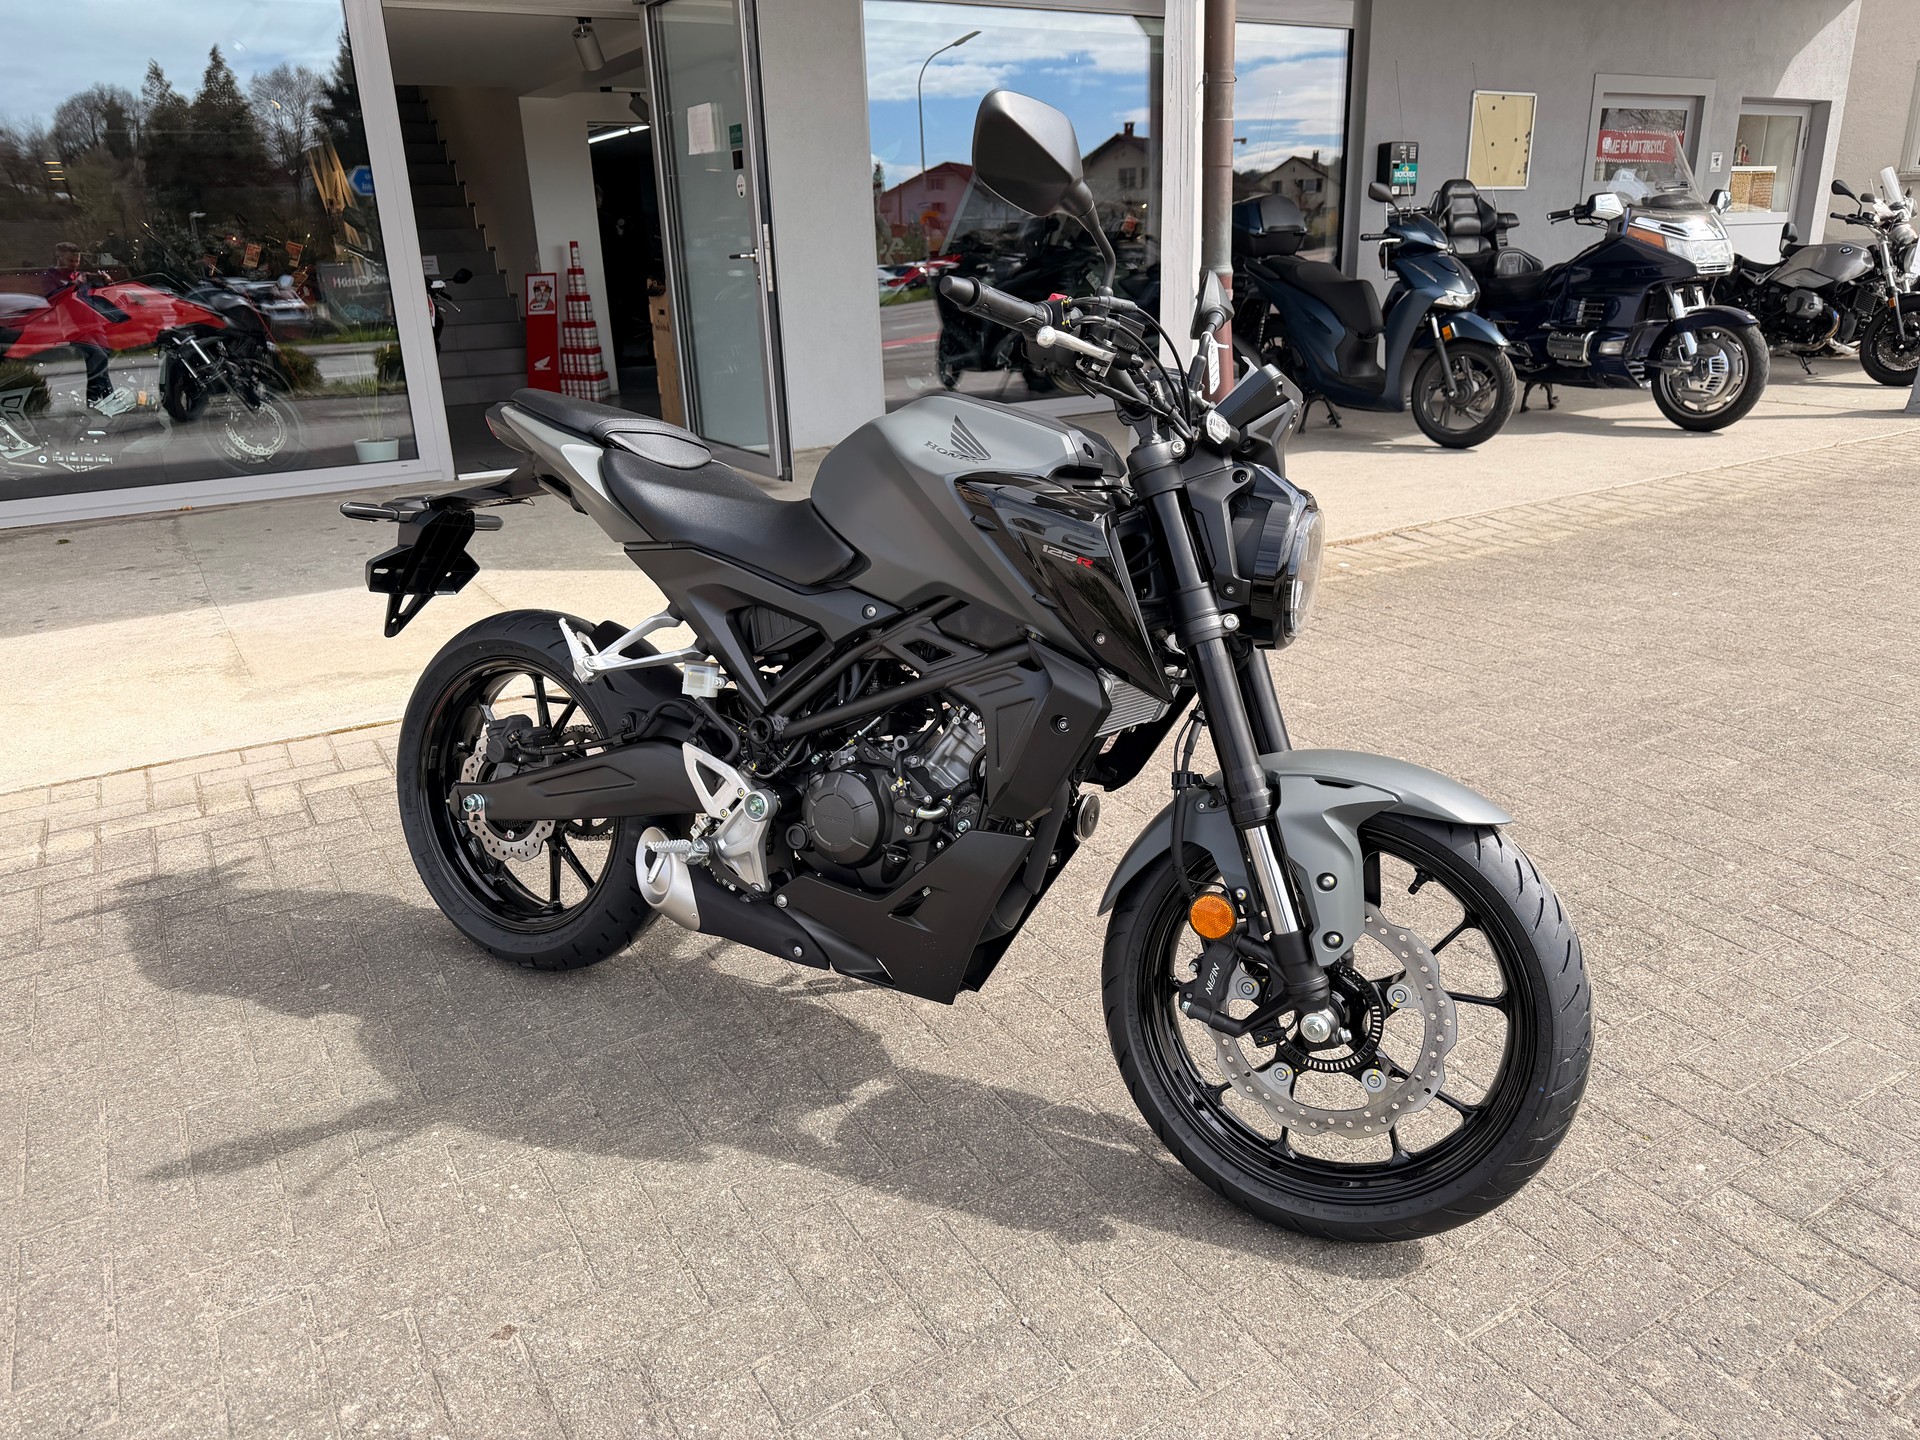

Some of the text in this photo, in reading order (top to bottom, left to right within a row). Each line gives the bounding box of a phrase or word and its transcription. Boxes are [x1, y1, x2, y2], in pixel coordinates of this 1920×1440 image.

[1621, 139, 1629, 153] OF
[1042, 544, 1094, 569] 125R
[1205, 962, 1220, 996] NISSIN
